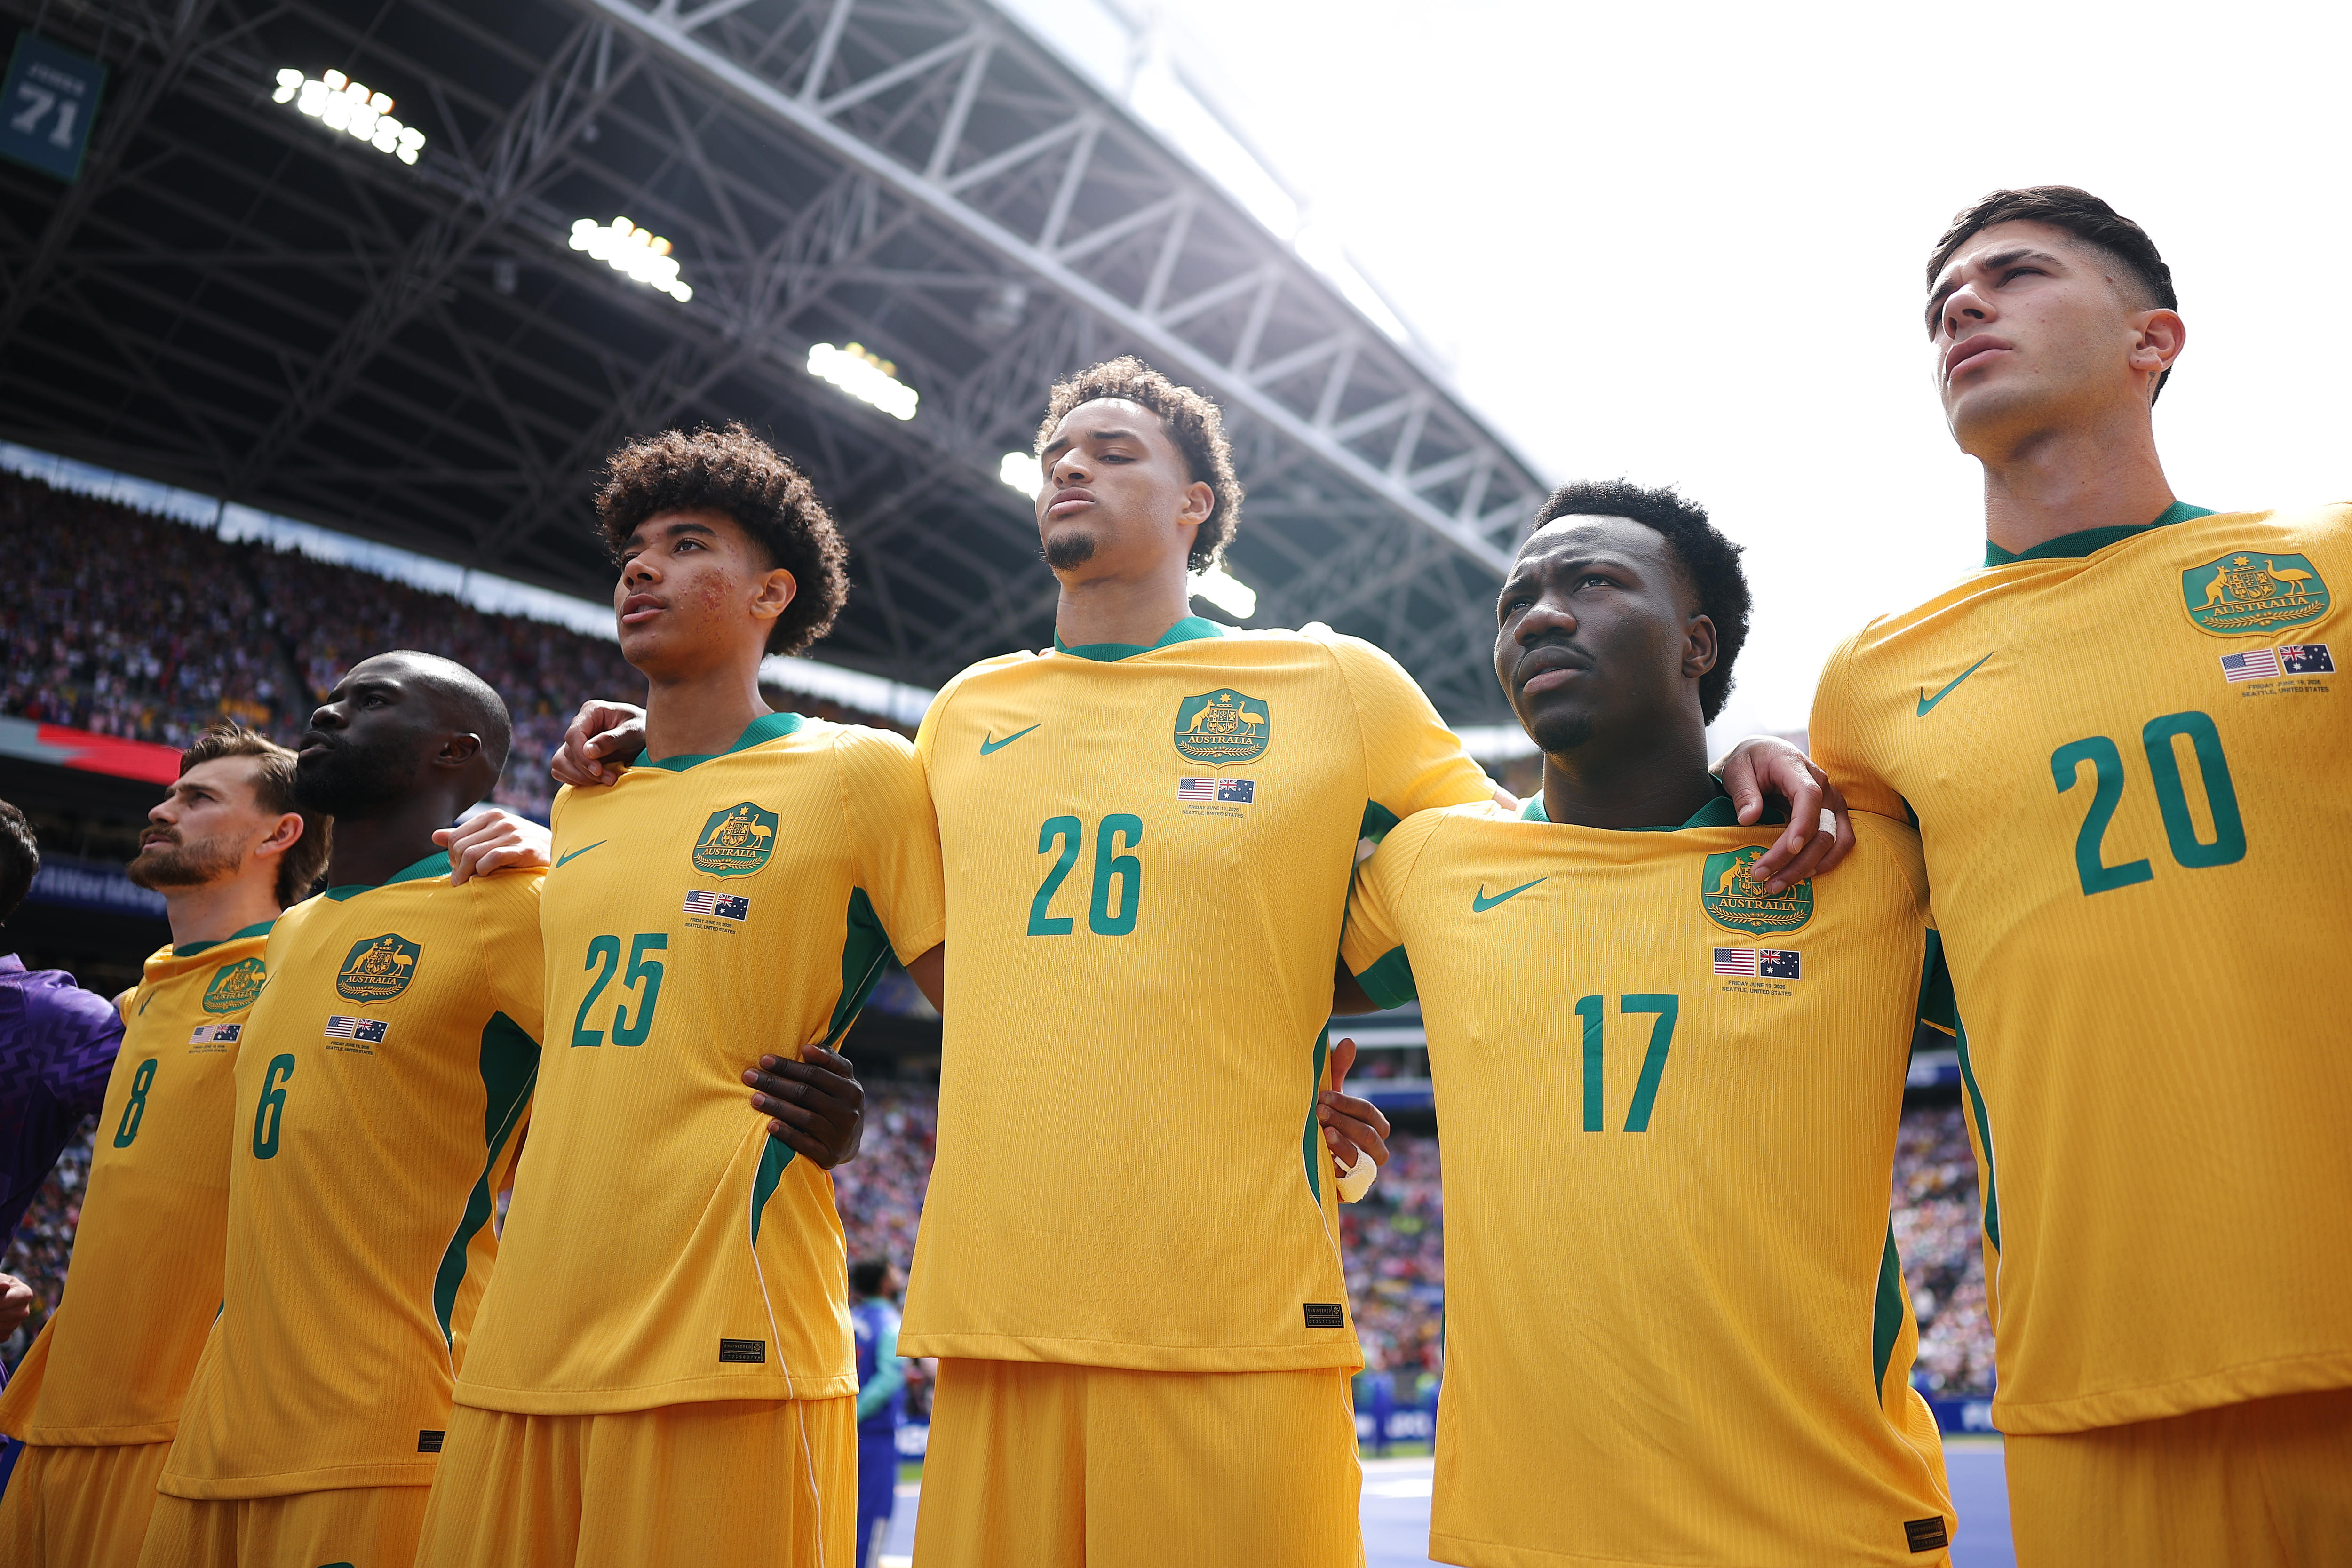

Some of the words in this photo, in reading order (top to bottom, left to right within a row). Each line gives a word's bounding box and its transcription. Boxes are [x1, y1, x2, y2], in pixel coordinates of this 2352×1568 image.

[11, 82, 78, 150] 71
[2213, 597, 2309, 617] AUSTRALIA
[1187, 736, 1254, 745] AUSTRALIA
[2052, 712, 2246, 895] 20
[702, 848, 756, 858] AUSTRALIA
[1028, 813, 1143, 936] 26
[1718, 898, 1796, 911] AUSTRALIA
[346, 975, 397, 985] AUSTRALIA
[572, 933, 667, 1047] 25
[1575, 994, 1678, 1132] 17
[114, 1059, 158, 1148] 8
[254, 1054, 295, 1159] 6
